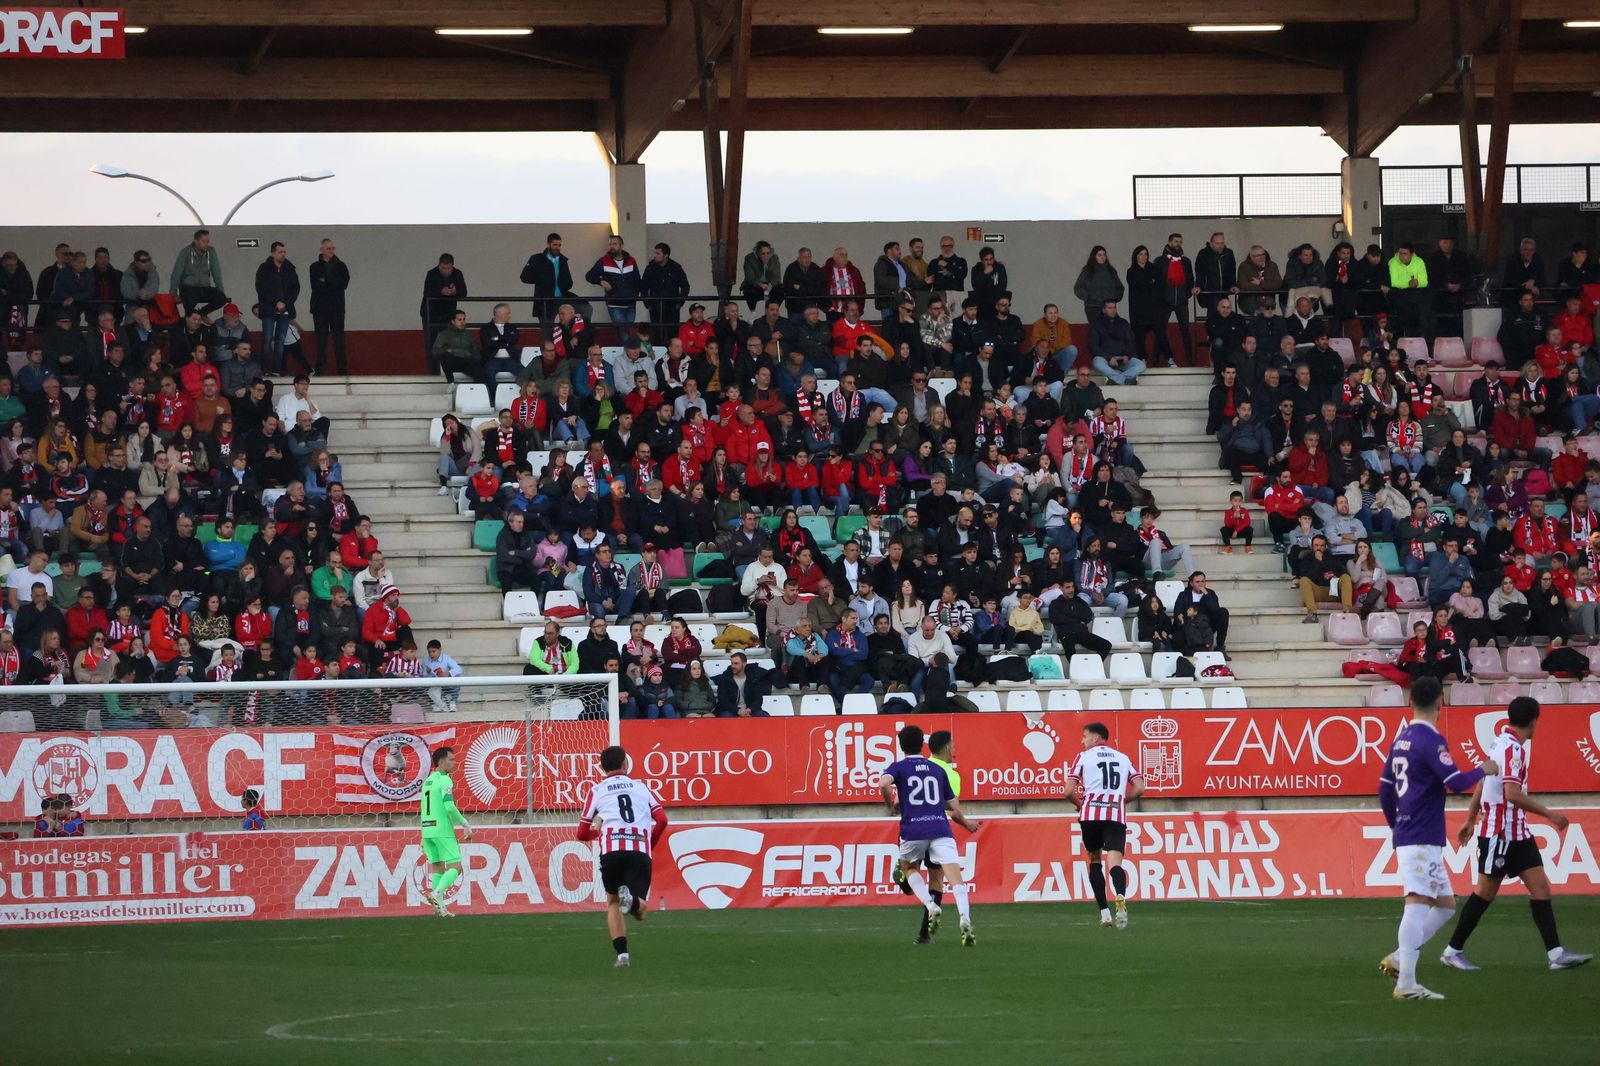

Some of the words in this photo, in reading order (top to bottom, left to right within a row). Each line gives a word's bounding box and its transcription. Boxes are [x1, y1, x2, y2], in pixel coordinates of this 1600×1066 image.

[377, 736, 414, 744] FONDO
[644, 741, 773, 776] ÓPTICO
[208, 731, 316, 812] CF
[1097, 761, 1121, 791] 16
[1204, 774, 1342, 790] AYUNTAMIENTO
[372, 779, 423, 797] MODORRO
[554, 777, 711, 805] RORTO
[907, 775, 940, 806] 20
[992, 784, 1040, 796] PODOLOGÍA
[1042, 786, 1049, 795] Y
[424, 790, 431, 816] 1
[617, 793, 635, 824] 8
[15, 848, 113, 867] bodegas
[185, 842, 218, 860] del
[0, 851, 244, 899] umiller
[1292, 872, 1343, 896] S.L.
[762, 885, 867, 897] REFRIGERACION
[0, 902, 246, 922] w.bodegasdelsumiller.com
